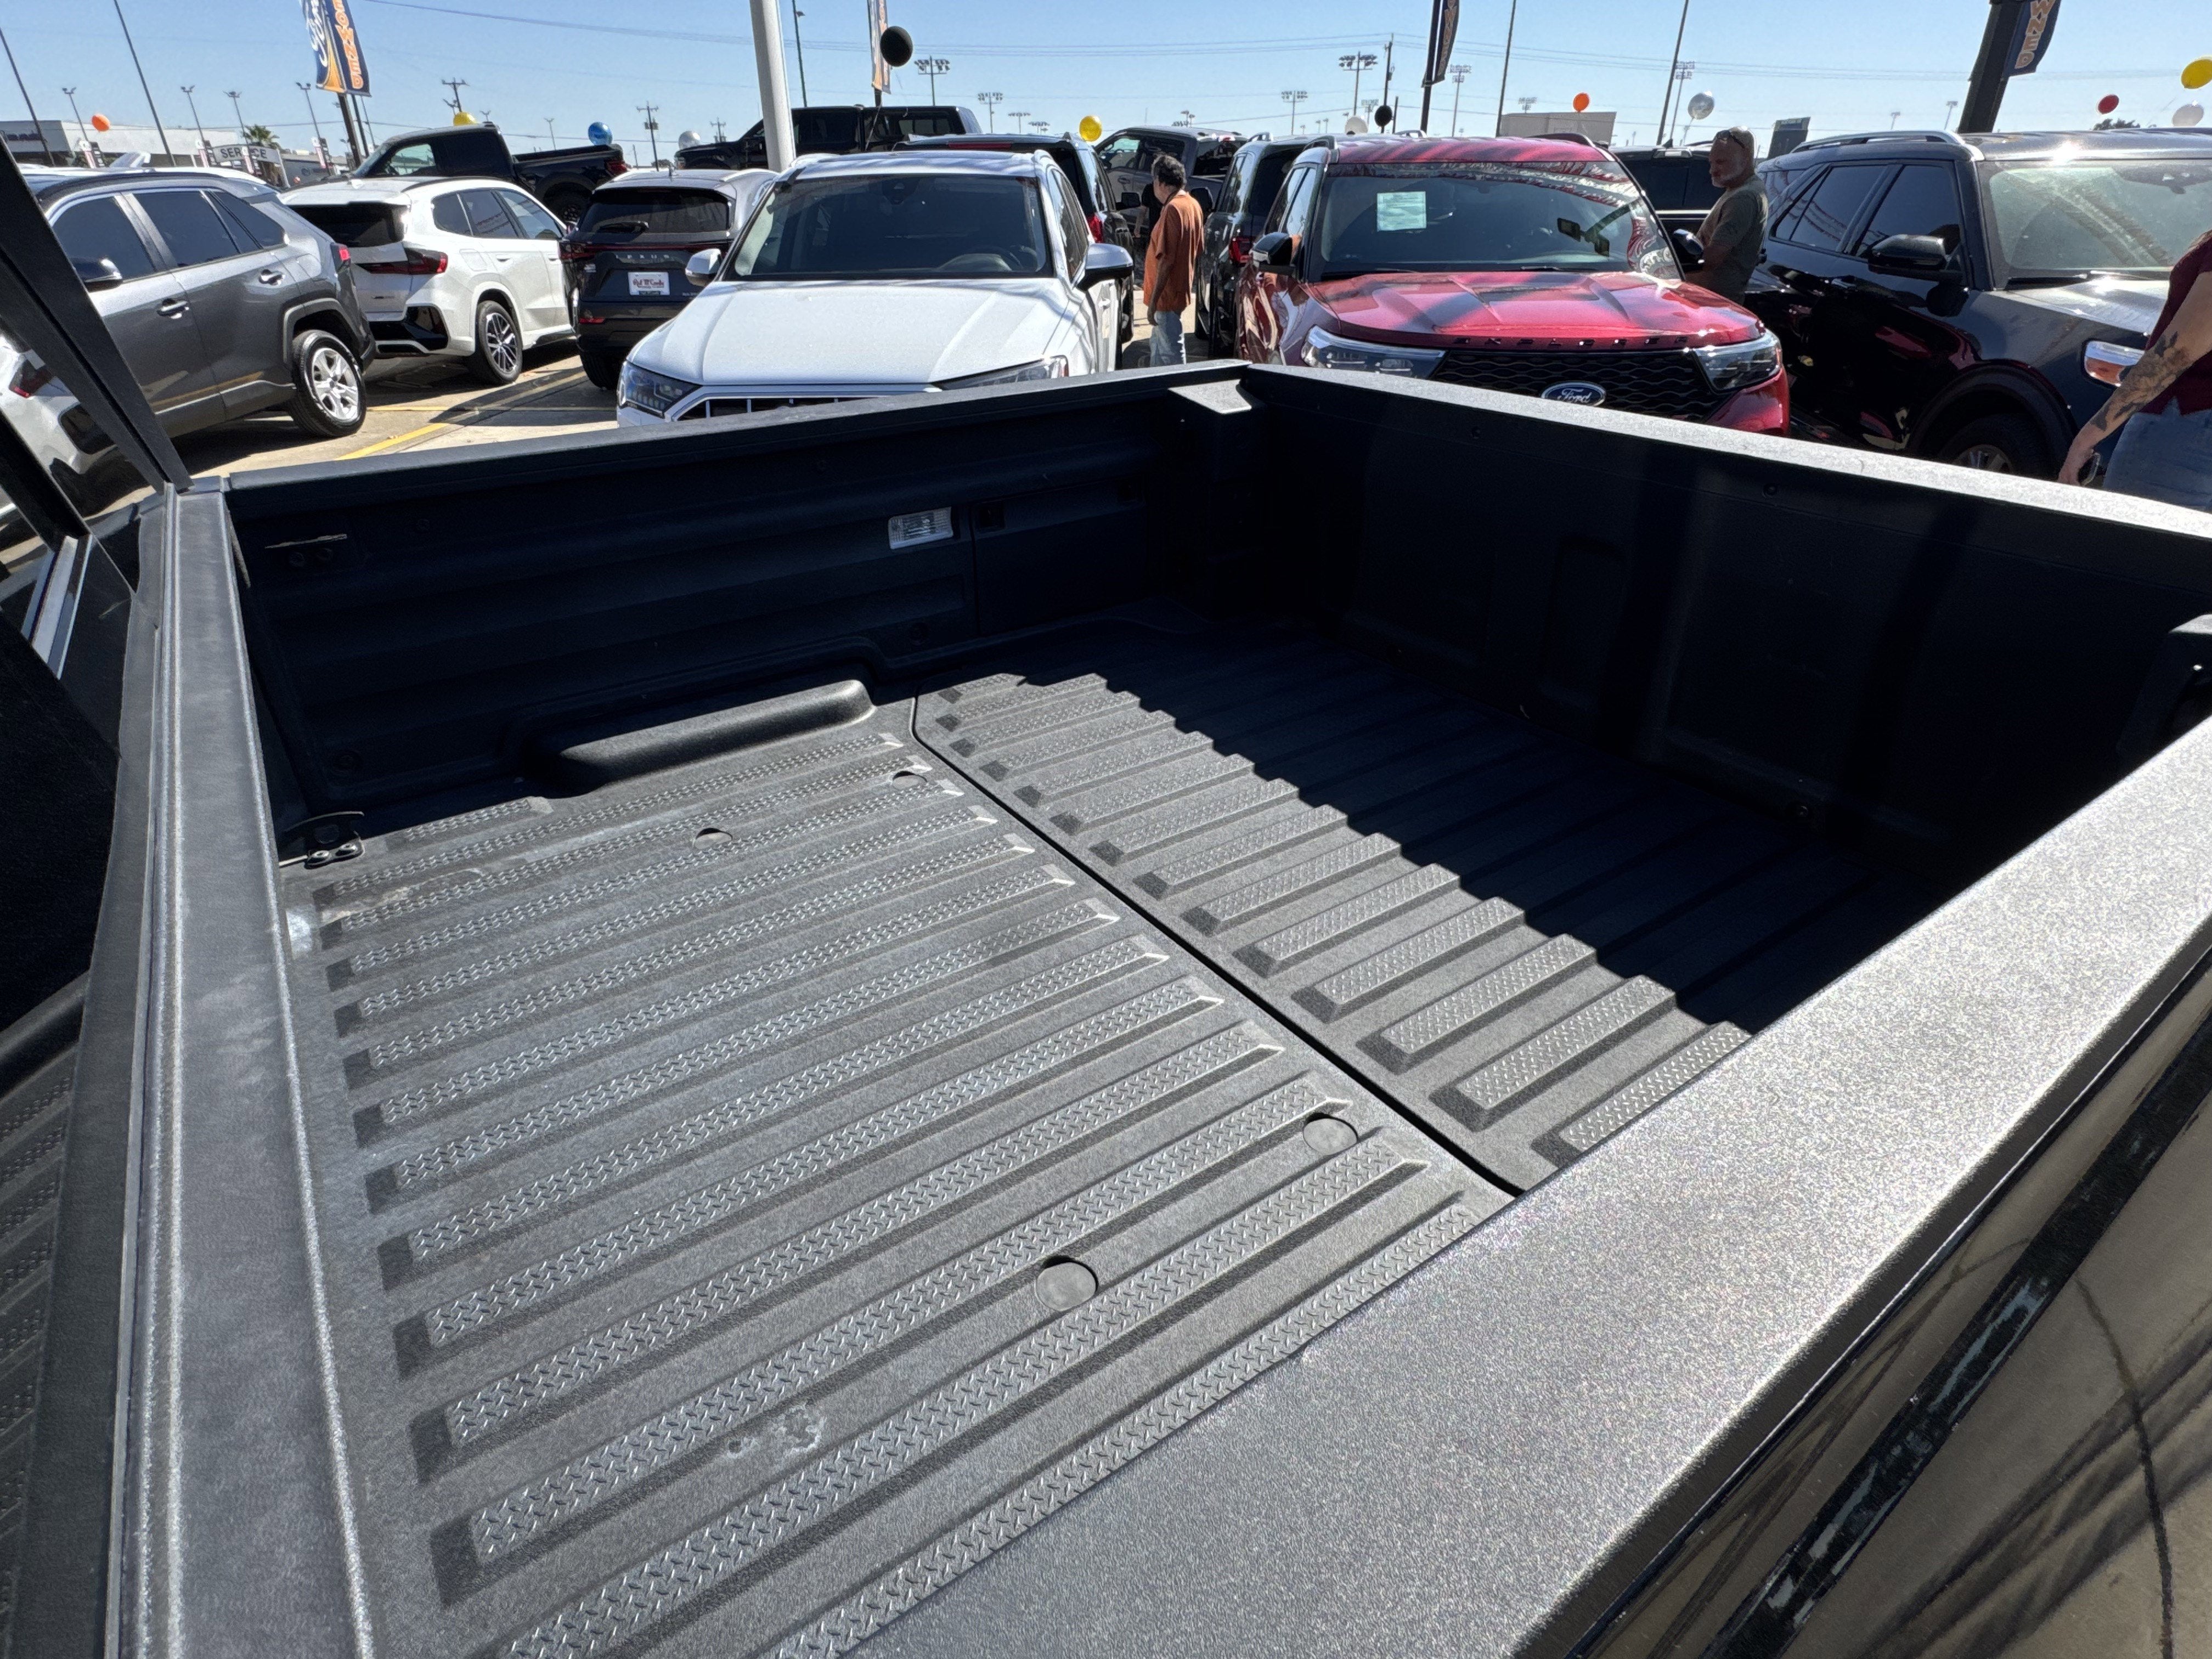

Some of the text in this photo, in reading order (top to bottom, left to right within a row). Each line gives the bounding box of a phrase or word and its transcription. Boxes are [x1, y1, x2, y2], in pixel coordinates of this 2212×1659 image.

[221, 146, 268, 159] SERCE
[1453, 336, 1689, 347] EXPLORER
[1557, 388, 1592, 403] Ford
